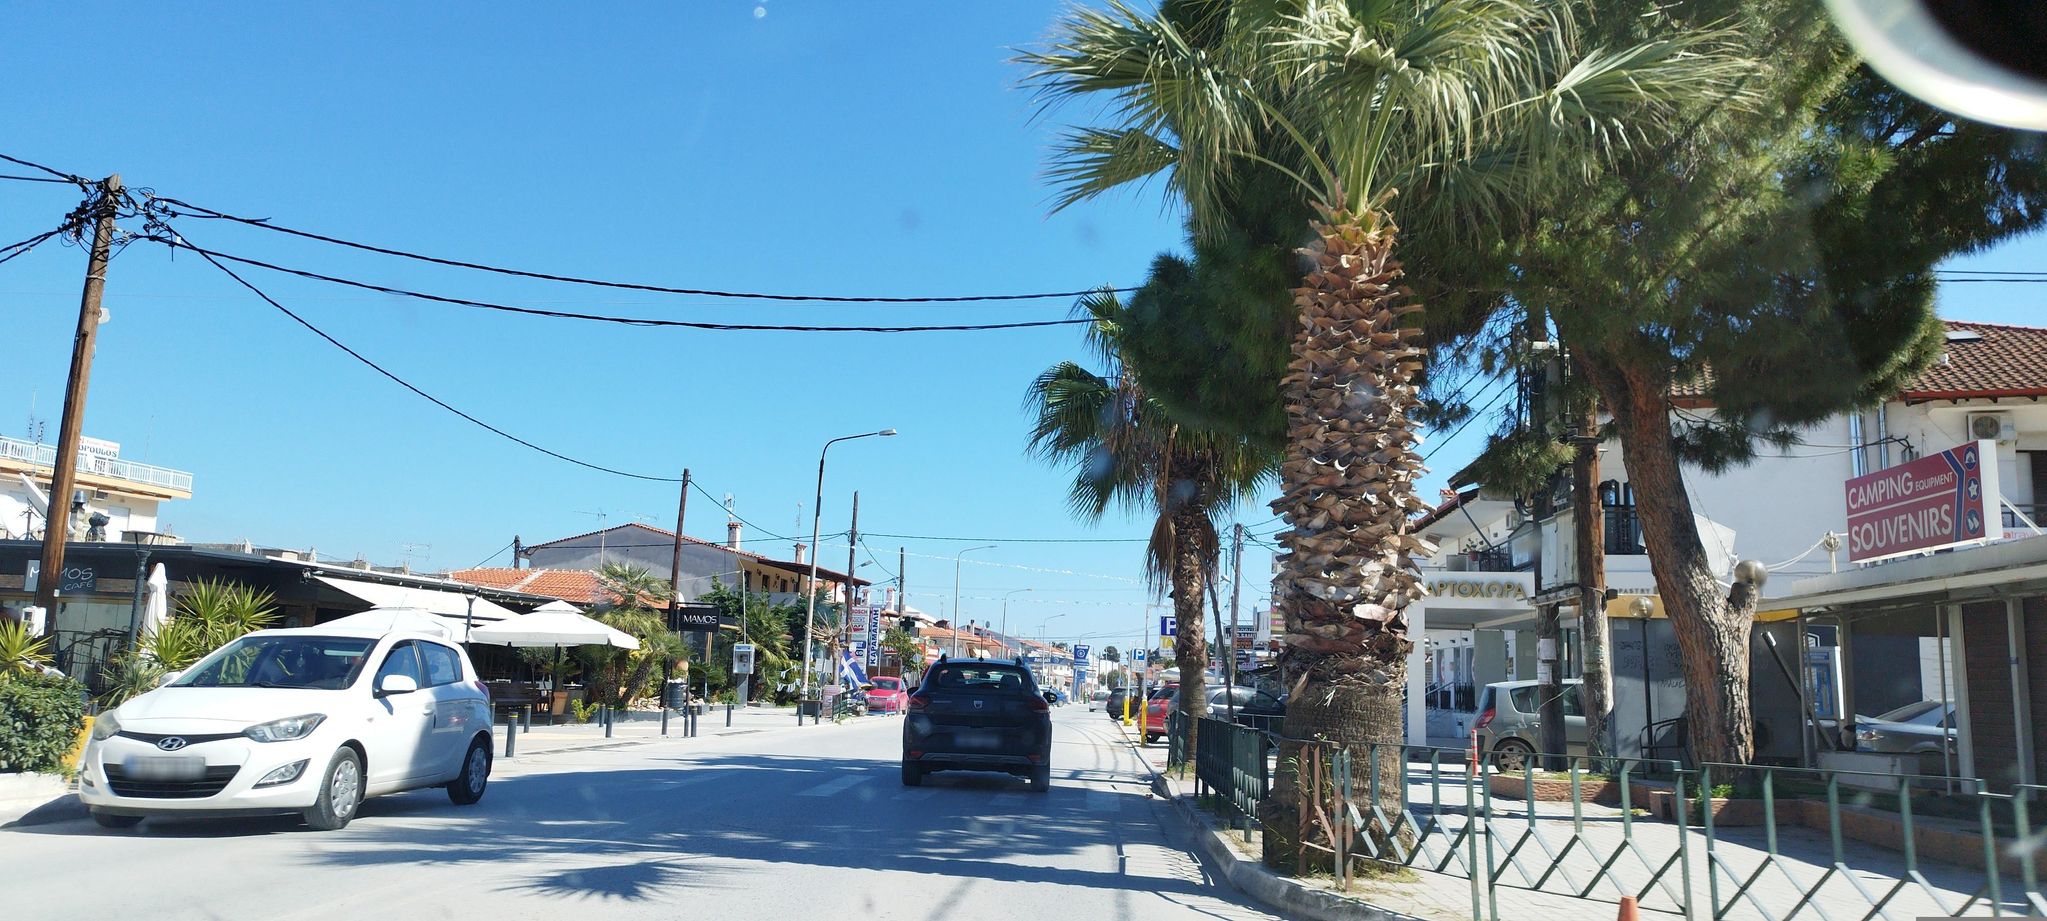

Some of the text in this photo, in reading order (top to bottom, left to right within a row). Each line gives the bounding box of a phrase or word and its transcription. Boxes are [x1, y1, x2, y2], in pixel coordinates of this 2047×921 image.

[1848, 472, 1953, 510] CAMPING EQUIPMENT
[1851, 503, 1953, 553] SOUVENIRS
[1426, 581, 1527, 598] ΑΡΤΟΧΩΡΑ
[683, 614, 717, 624] MAMOS
[870, 609, 879, 665] ΚΑΡΑΜΑΝΛΗ
[1135, 649, 1144, 660] P
